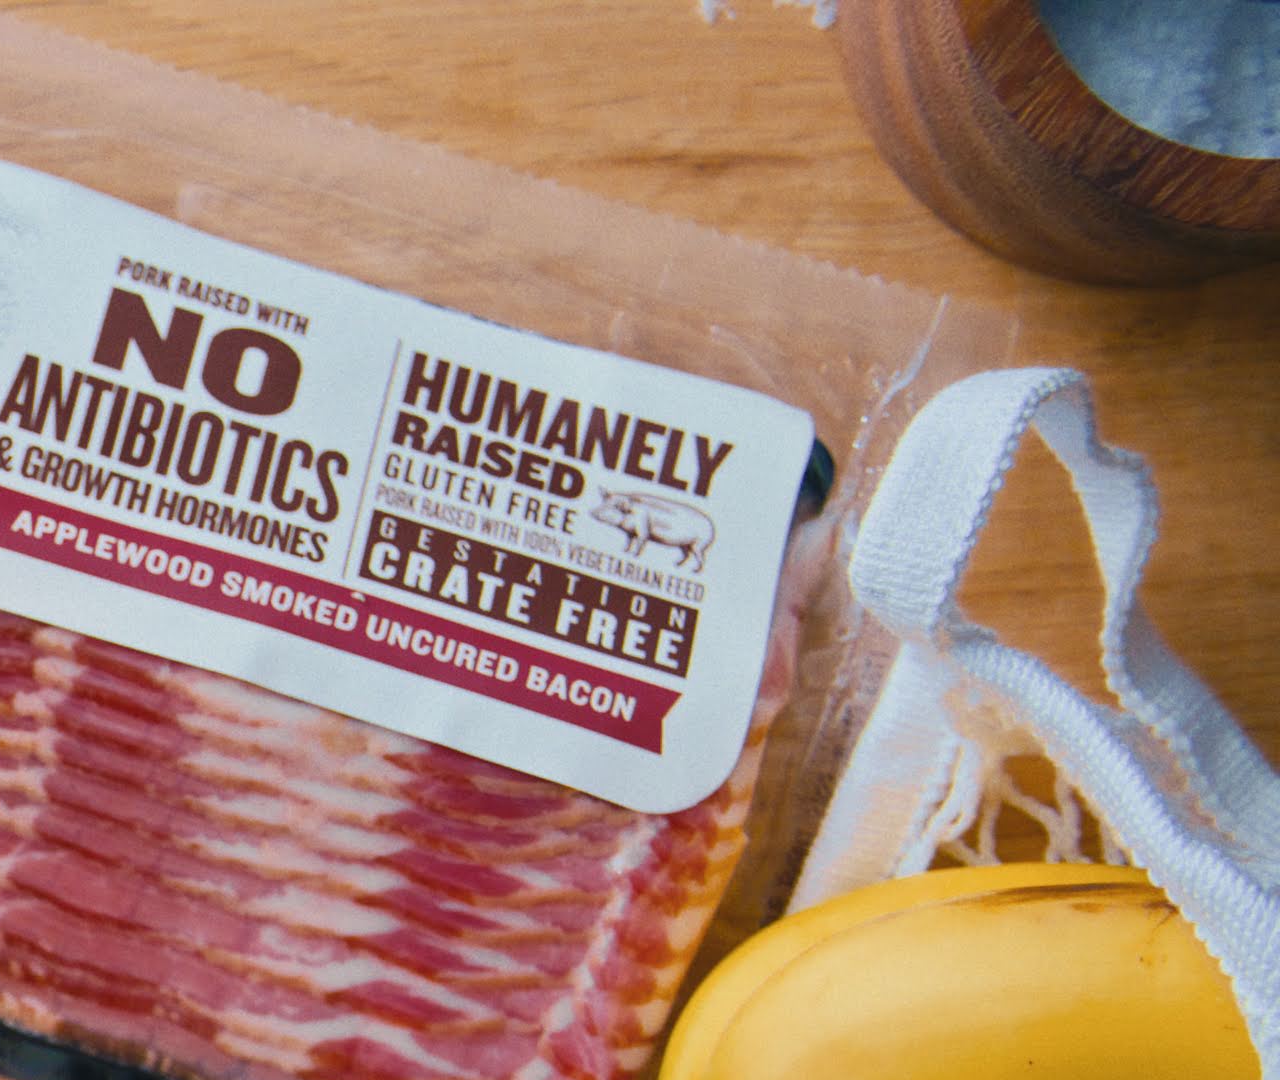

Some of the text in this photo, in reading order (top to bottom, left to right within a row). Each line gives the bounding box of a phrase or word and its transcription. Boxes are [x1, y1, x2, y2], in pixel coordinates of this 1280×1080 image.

[92, 286, 303, 417] NO
[117, 255, 311, 336] PORK RAISED WITH
[391, 411, 586, 500] RAISED
[402, 351, 735, 498] HUMANELY
[20, 445, 152, 515] GROWTH
[154, 487, 329, 564] HORMONES
[376, 483, 706, 602] PORK RAISED WITH 100% VEGETARIAN FEED
[383, 452, 579, 536] GLUTEN FREE
[10, 510, 637, 723] APPLEWOOD SMOKED UNCURED BACON
[368, 542, 690, 671] CRATE FREE
[380, 516, 687, 630] GESTATION
